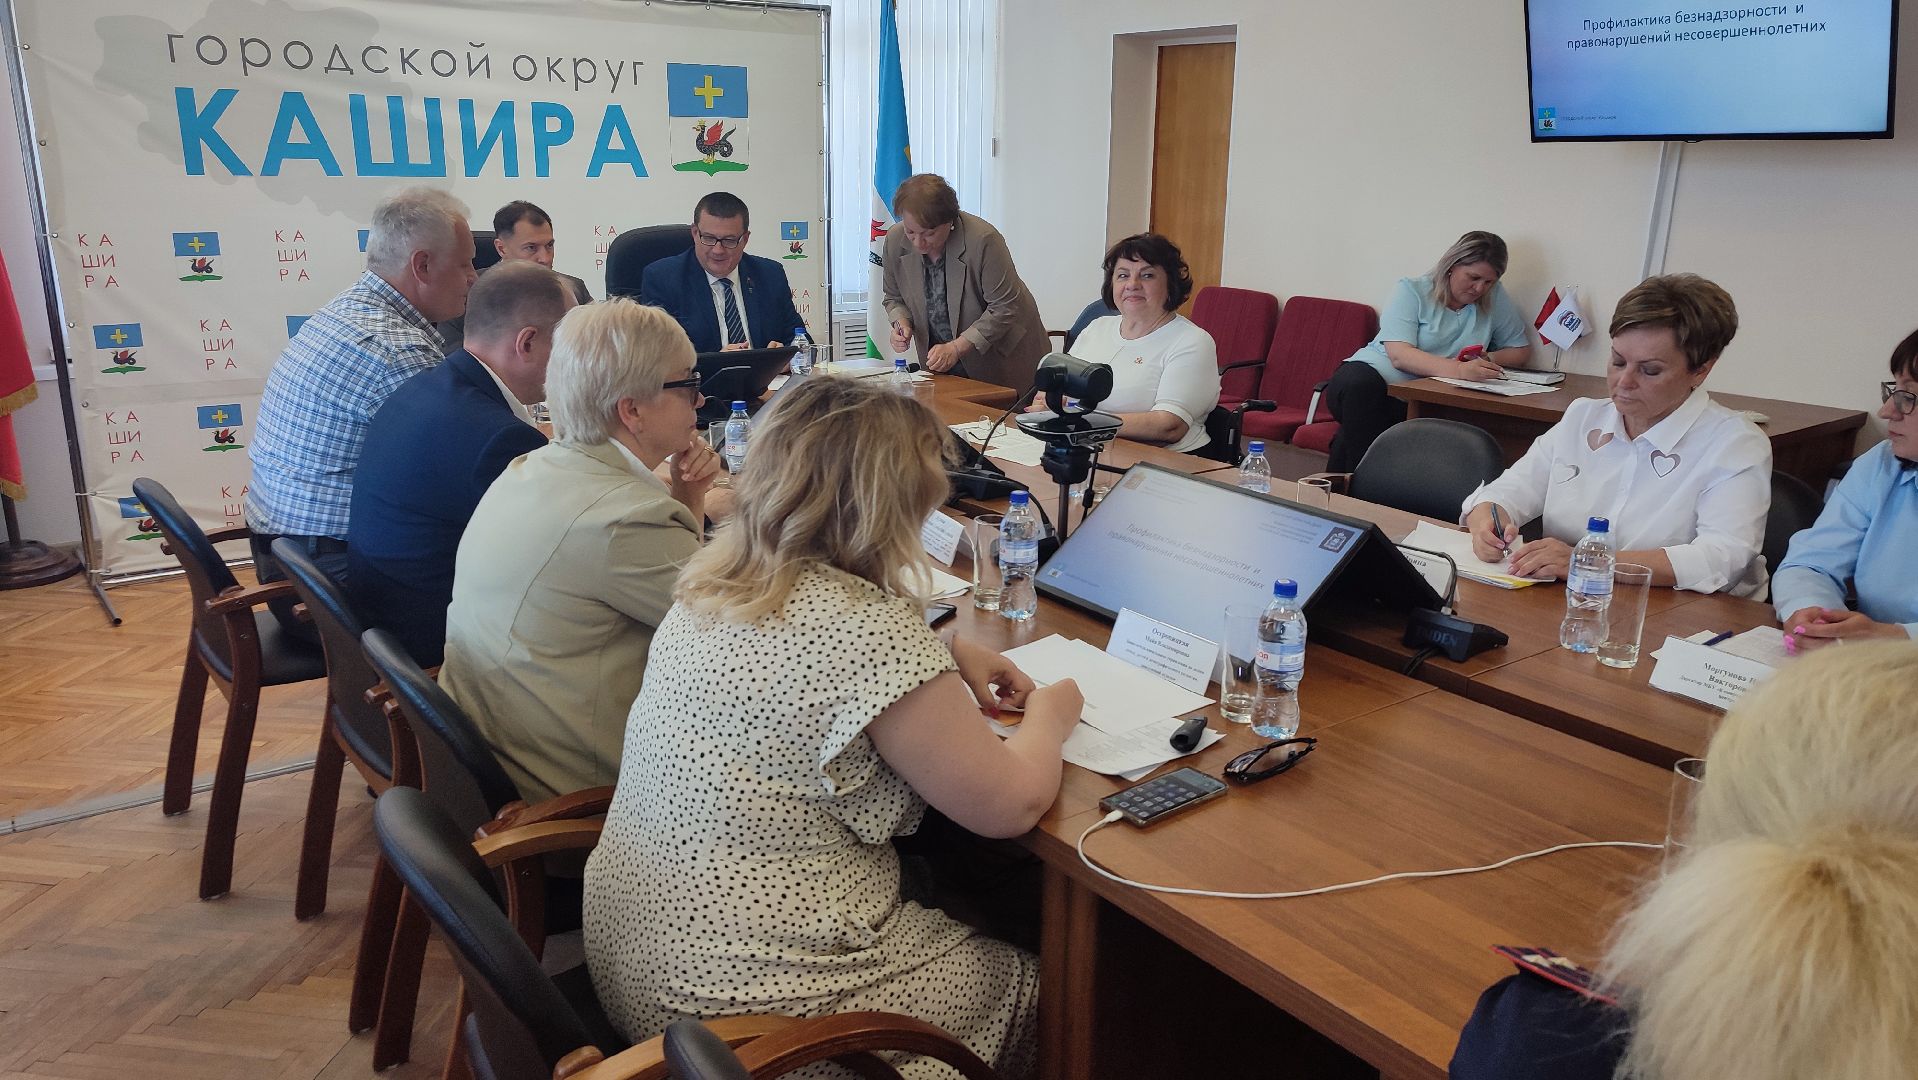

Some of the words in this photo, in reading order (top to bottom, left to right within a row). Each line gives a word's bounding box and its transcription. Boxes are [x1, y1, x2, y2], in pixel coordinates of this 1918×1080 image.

[1567, 30, 1671, 51] правонарушений
[1675, 21, 1827, 42] несовершеннолетних
[1583, 15, 1671, 33] Профилактика
[1675, 5, 1787, 24] безнадзорности
[1795, 4, 1804, 13] и
[167, 33, 491, 79] городской
[513, 54, 644, 93] округ
[174, 86, 650, 178] КАШИРА
